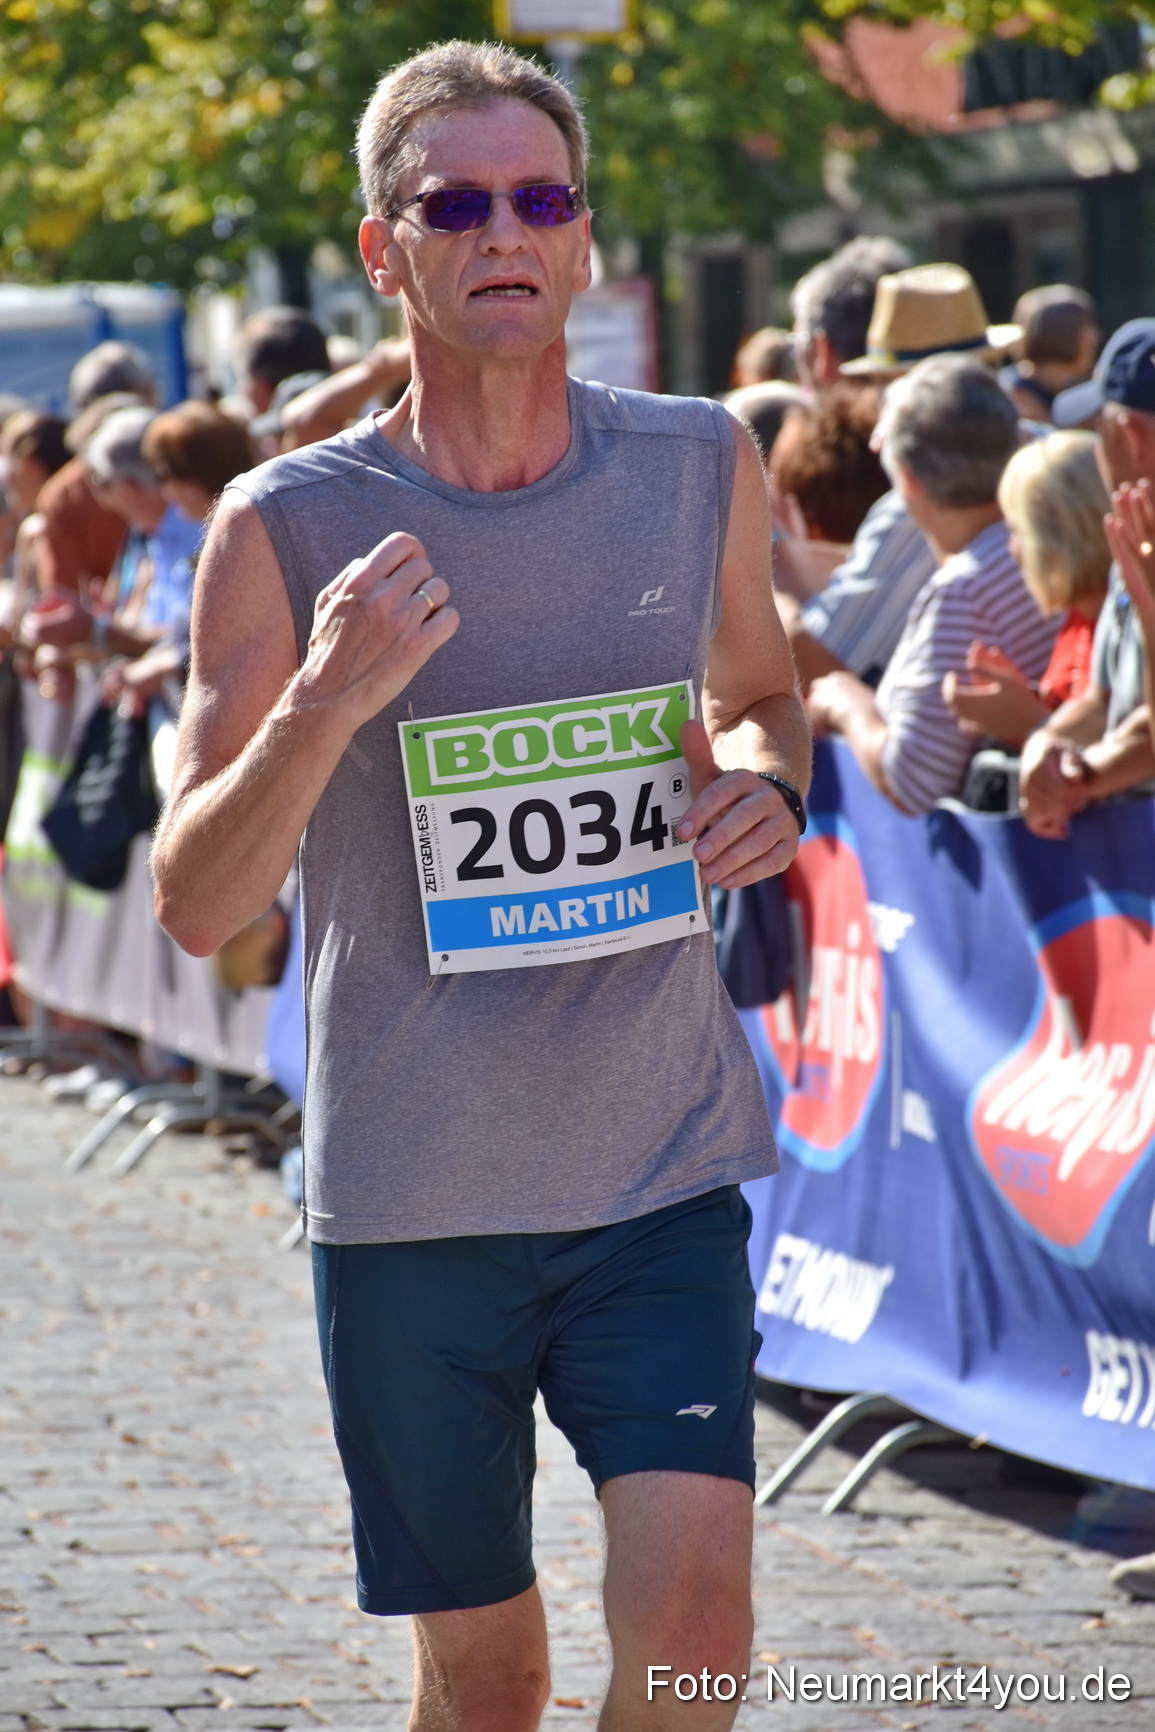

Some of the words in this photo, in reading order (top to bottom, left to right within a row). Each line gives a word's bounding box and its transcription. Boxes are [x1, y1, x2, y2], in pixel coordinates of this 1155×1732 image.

[648, 607, 676, 615] TOUCH
[425, 698, 674, 785] BOCK
[673, 779, 683, 793] B
[450, 781, 668, 881] 2034
[489, 884, 650, 937] MARTIN
